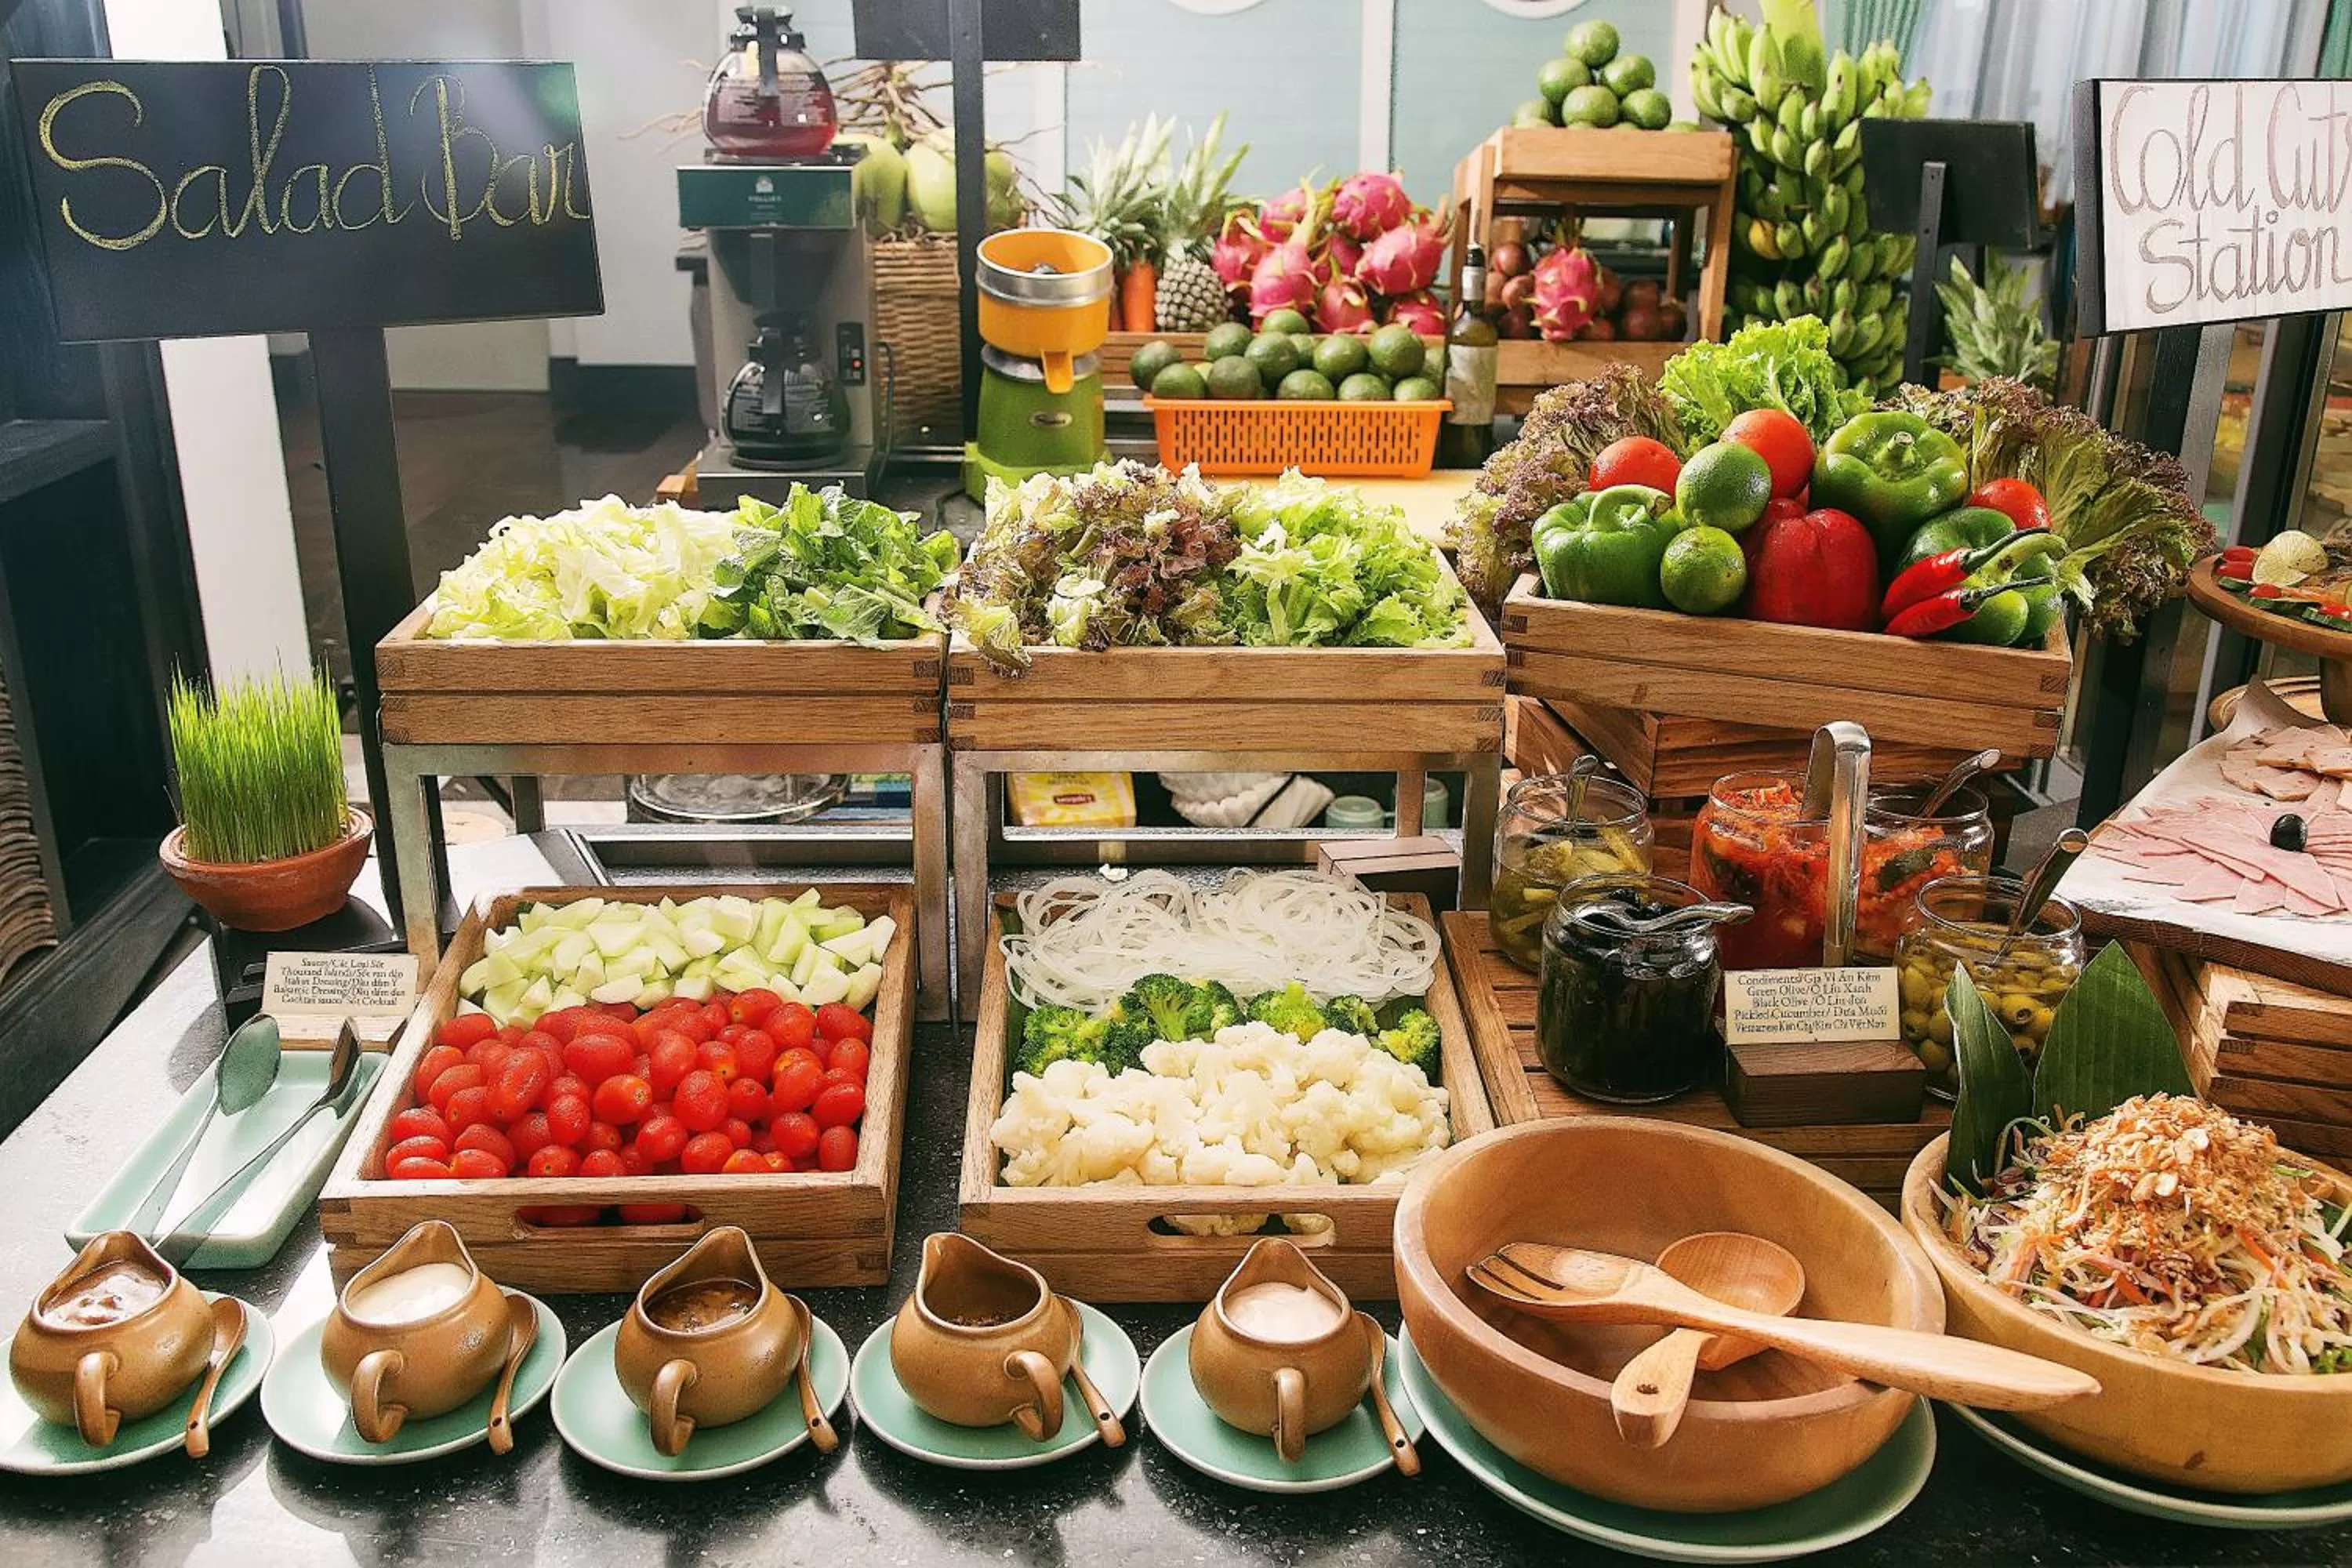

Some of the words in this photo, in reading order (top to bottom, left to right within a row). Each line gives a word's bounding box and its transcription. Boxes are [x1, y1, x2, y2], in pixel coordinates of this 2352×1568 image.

[38, 63, 416, 251] Salad
[408, 74, 591, 241] Bar
[2110, 83, 2256, 216] Cold
[2139, 205, 2352, 314] Station
[1747, 986, 1777, 997] Green
[1752, 996, 1779, 1008] Black
